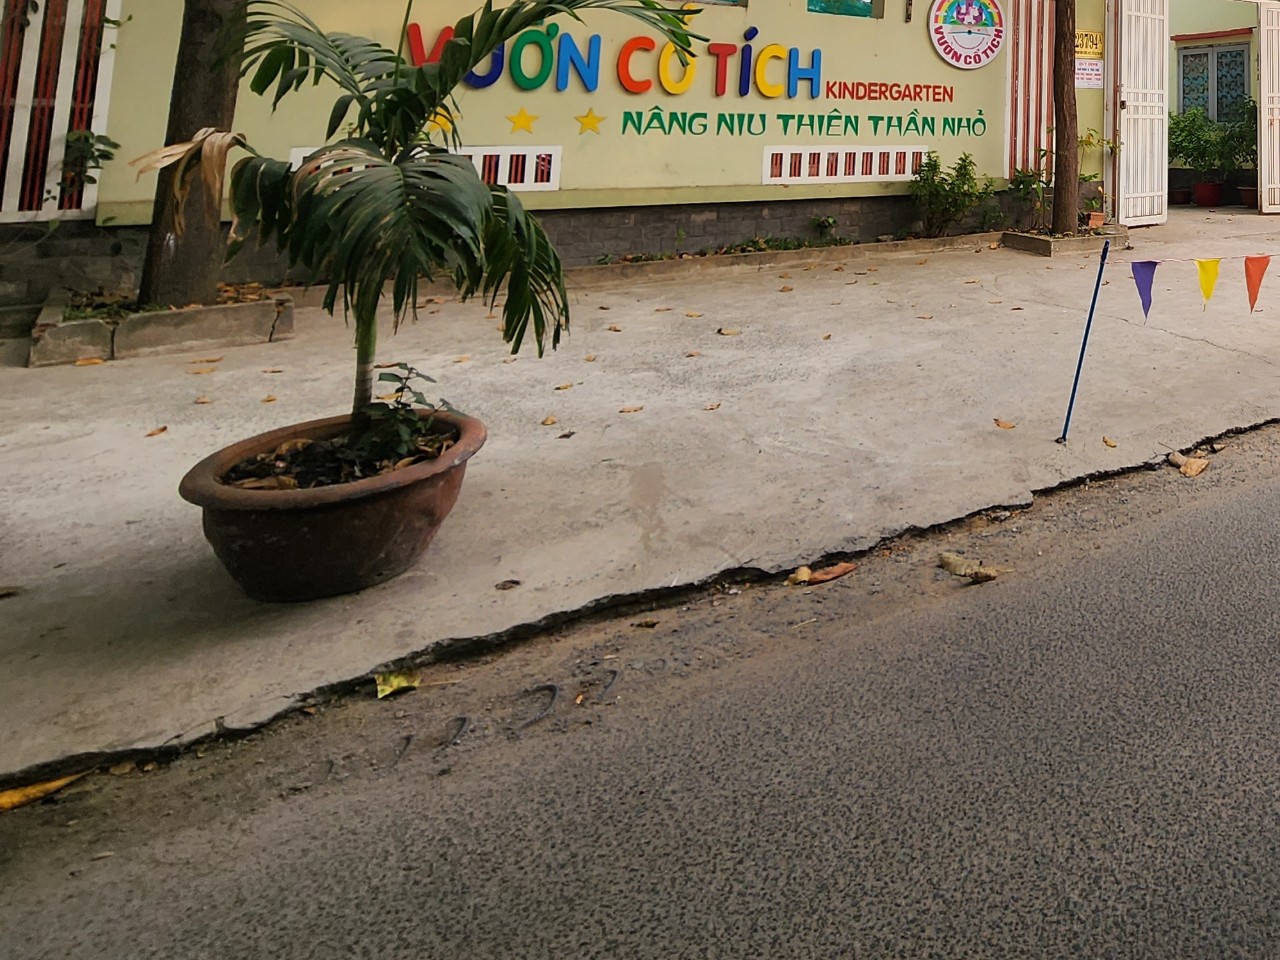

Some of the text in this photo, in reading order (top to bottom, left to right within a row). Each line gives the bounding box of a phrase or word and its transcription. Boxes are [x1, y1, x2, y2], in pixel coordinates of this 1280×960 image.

[707, 26, 822, 99] TÍCH
[963, 48, 982, 66] CỔ
[825, 80, 954, 103] KINDERGARTEN
[621, 105, 987, 137] NÂNG NIU THIÊN THẦN NHỎ
